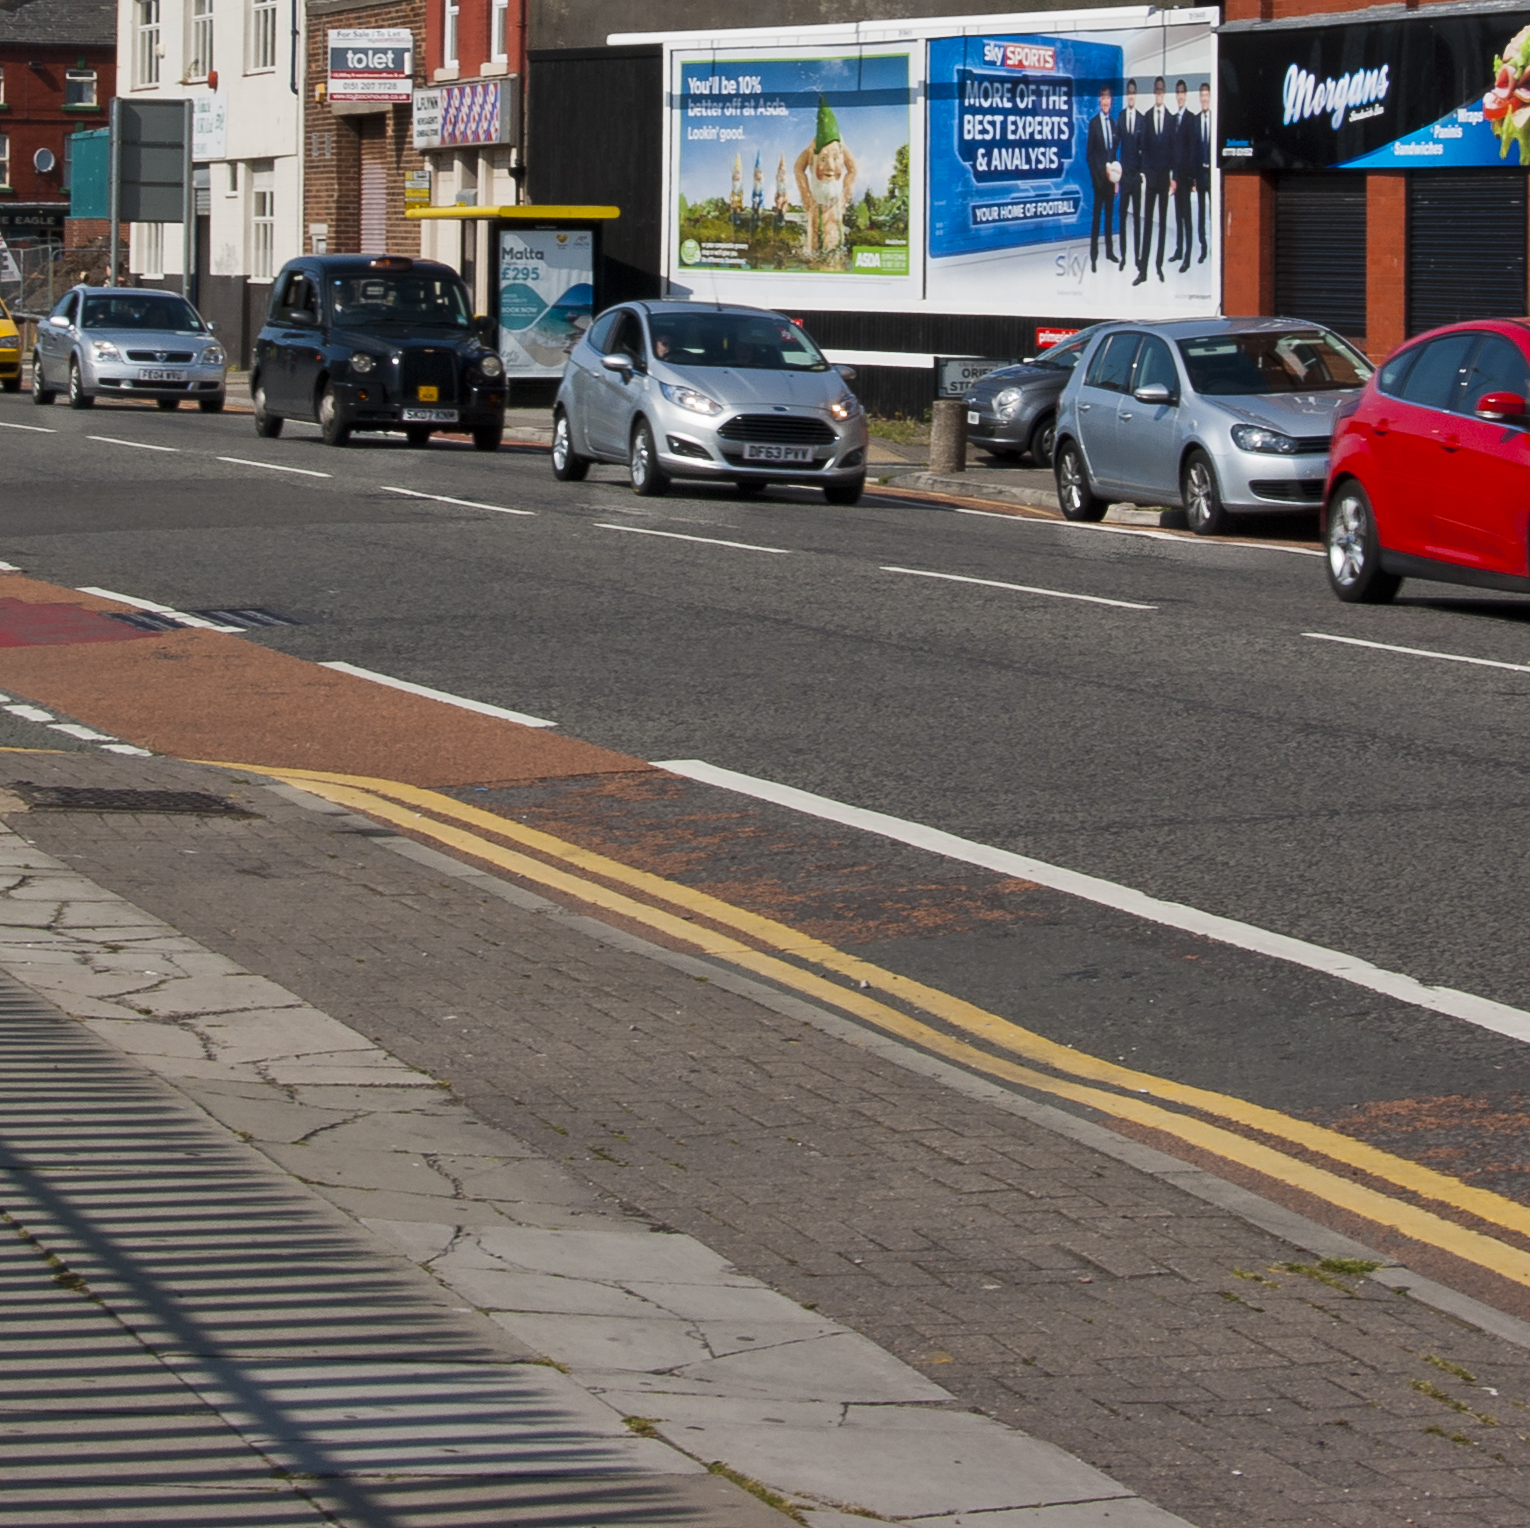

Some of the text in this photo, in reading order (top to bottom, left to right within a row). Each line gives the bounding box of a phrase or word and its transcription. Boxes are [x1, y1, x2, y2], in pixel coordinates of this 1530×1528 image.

[984, 44, 1054, 67] sky SPORTS
[688, 76, 762, 94] You'll be 10%
[964, 80, 1069, 109] MORE OF THE
[1283, 63, 1389, 130] Morgans
[688, 99, 722, 116] better
[724, 98, 742, 116] off
[743, 99, 755, 116] at
[1457, 109, 1483, 125] Wraps
[688, 125, 745, 143] Lookin' good.
[963, 115, 1069, 140] BEST EXPERTS
[1394, 141, 1444, 156] Sandwiches
[976, 147, 1058, 171] & ANALYSIS
[976, 200, 1075, 221] YOUR HOME OF FOOTBALL
[16, 216, 56, 225] EAGLE
[502, 247, 545, 261] Malta
[855, 252, 881, 267] ASDA
[1055, 245, 1088, 284] sky
[501, 267, 540, 281] £295
[962, 368, 994, 379] ORIE
[749, 445, 782, 459] DF63
